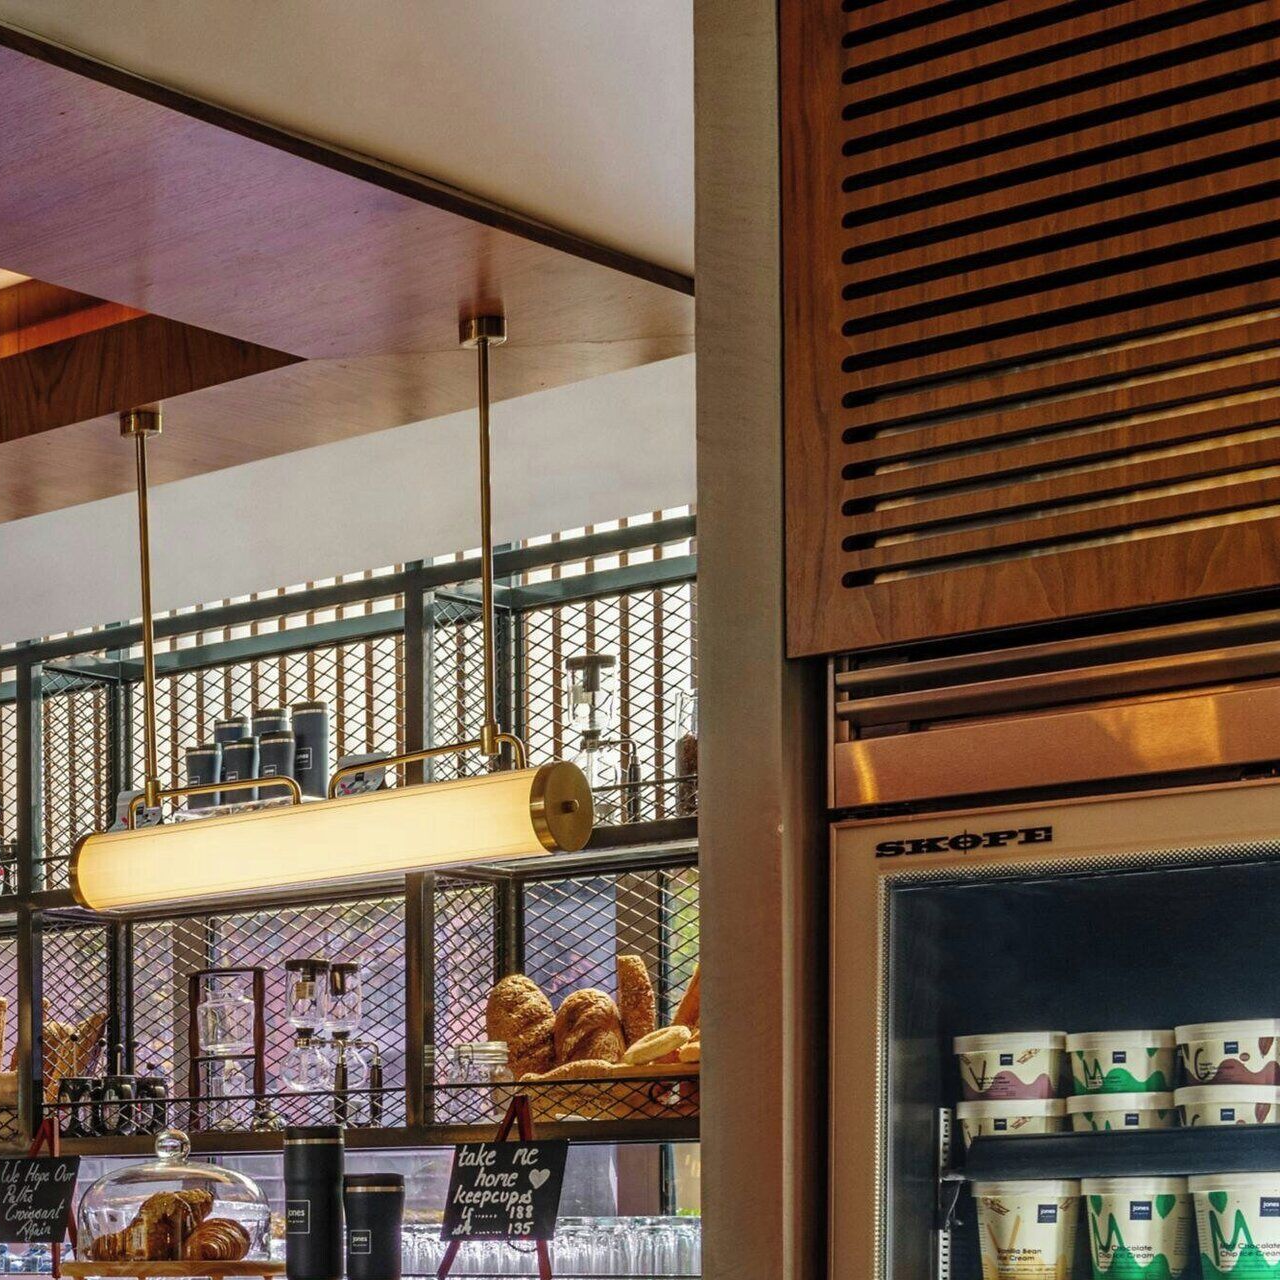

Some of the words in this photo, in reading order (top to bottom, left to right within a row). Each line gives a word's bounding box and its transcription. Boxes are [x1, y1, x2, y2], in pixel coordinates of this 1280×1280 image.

[875, 826, 1053, 858] SKOPE
[458, 1143, 497, 1167] take
[1, 1161, 20, 1183] We
[24, 1162, 50, 1191] Hope
[54, 1163, 75, 1182] Our
[474, 1166, 519, 1188] home
[5, 1199, 65, 1221] Croissant
[288, 1209, 306, 1218] jones
[508, 1221, 535, 1235] 135
